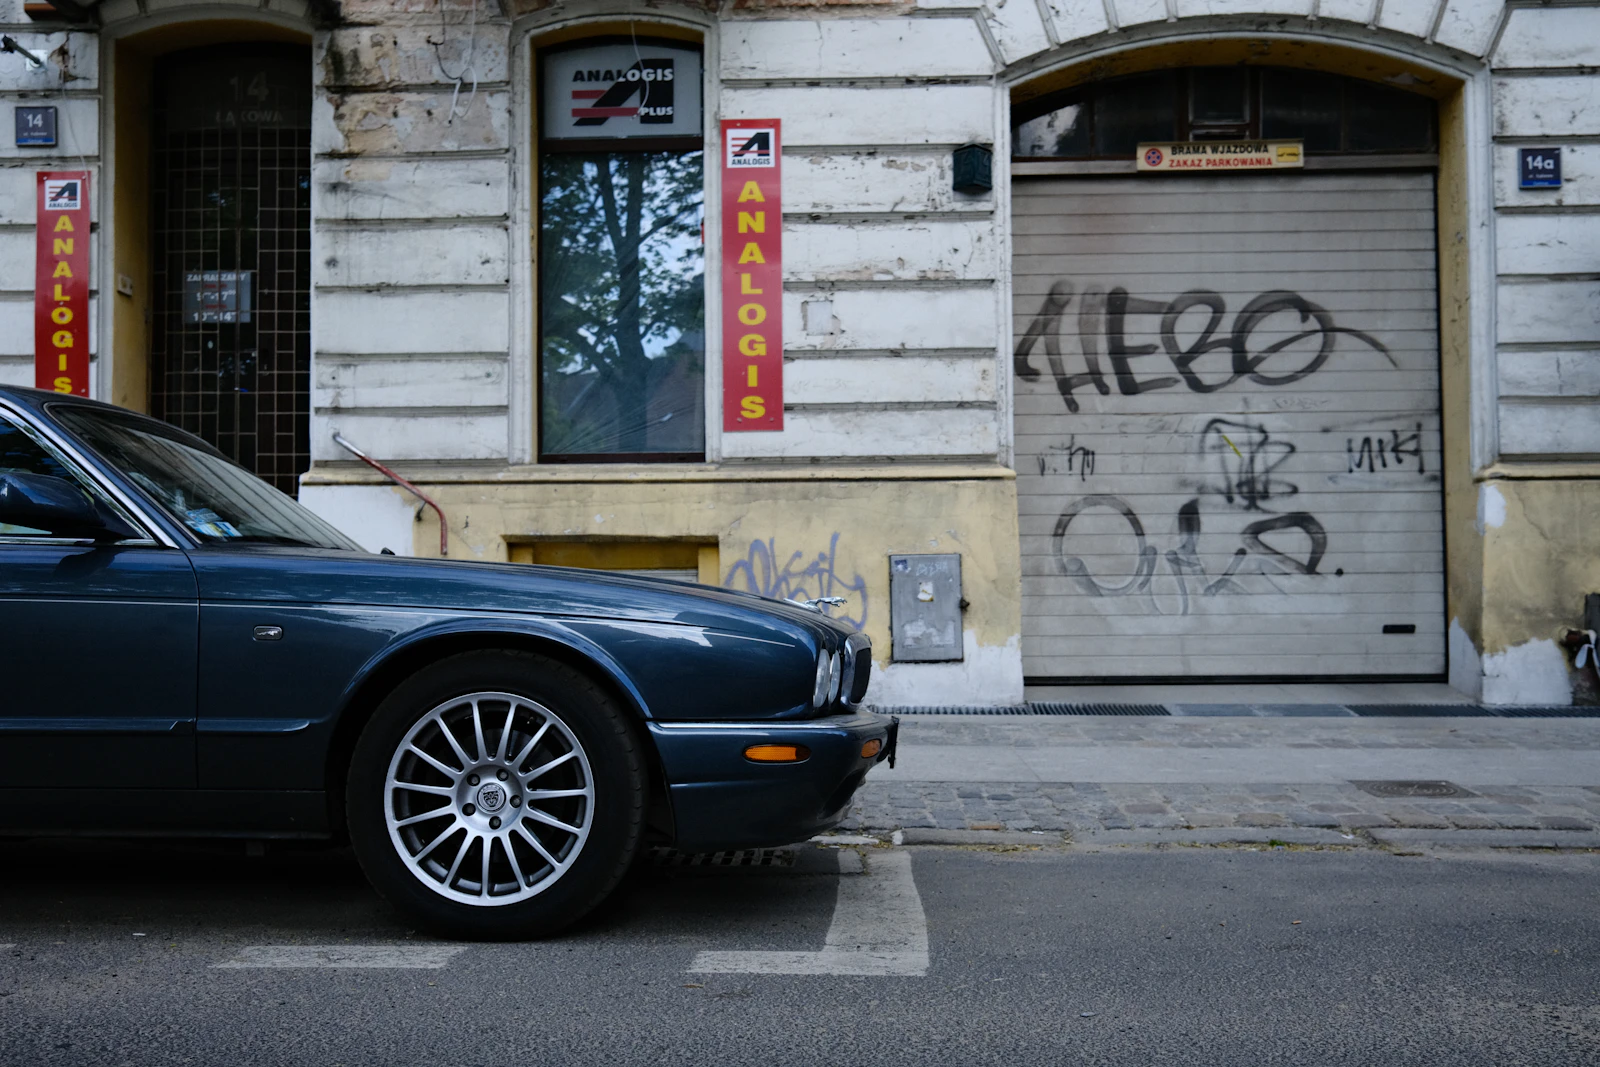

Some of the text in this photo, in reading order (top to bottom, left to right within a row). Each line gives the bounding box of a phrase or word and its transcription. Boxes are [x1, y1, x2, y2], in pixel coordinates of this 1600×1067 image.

[572, 68, 673, 82] ANALOGIS
[640, 107, 673, 116] PLUS
[27, 113, 44, 128] 14
[1171, 144, 1269, 155] BRAMA WJAZDOWA
[1169, 158, 1272, 168] ZAKAZ PARKOWANIA
[1526, 154, 1555, 170] 14a
[51, 214, 75, 394] ANALOGIS
[737, 180, 767, 420] ANALOGIS
